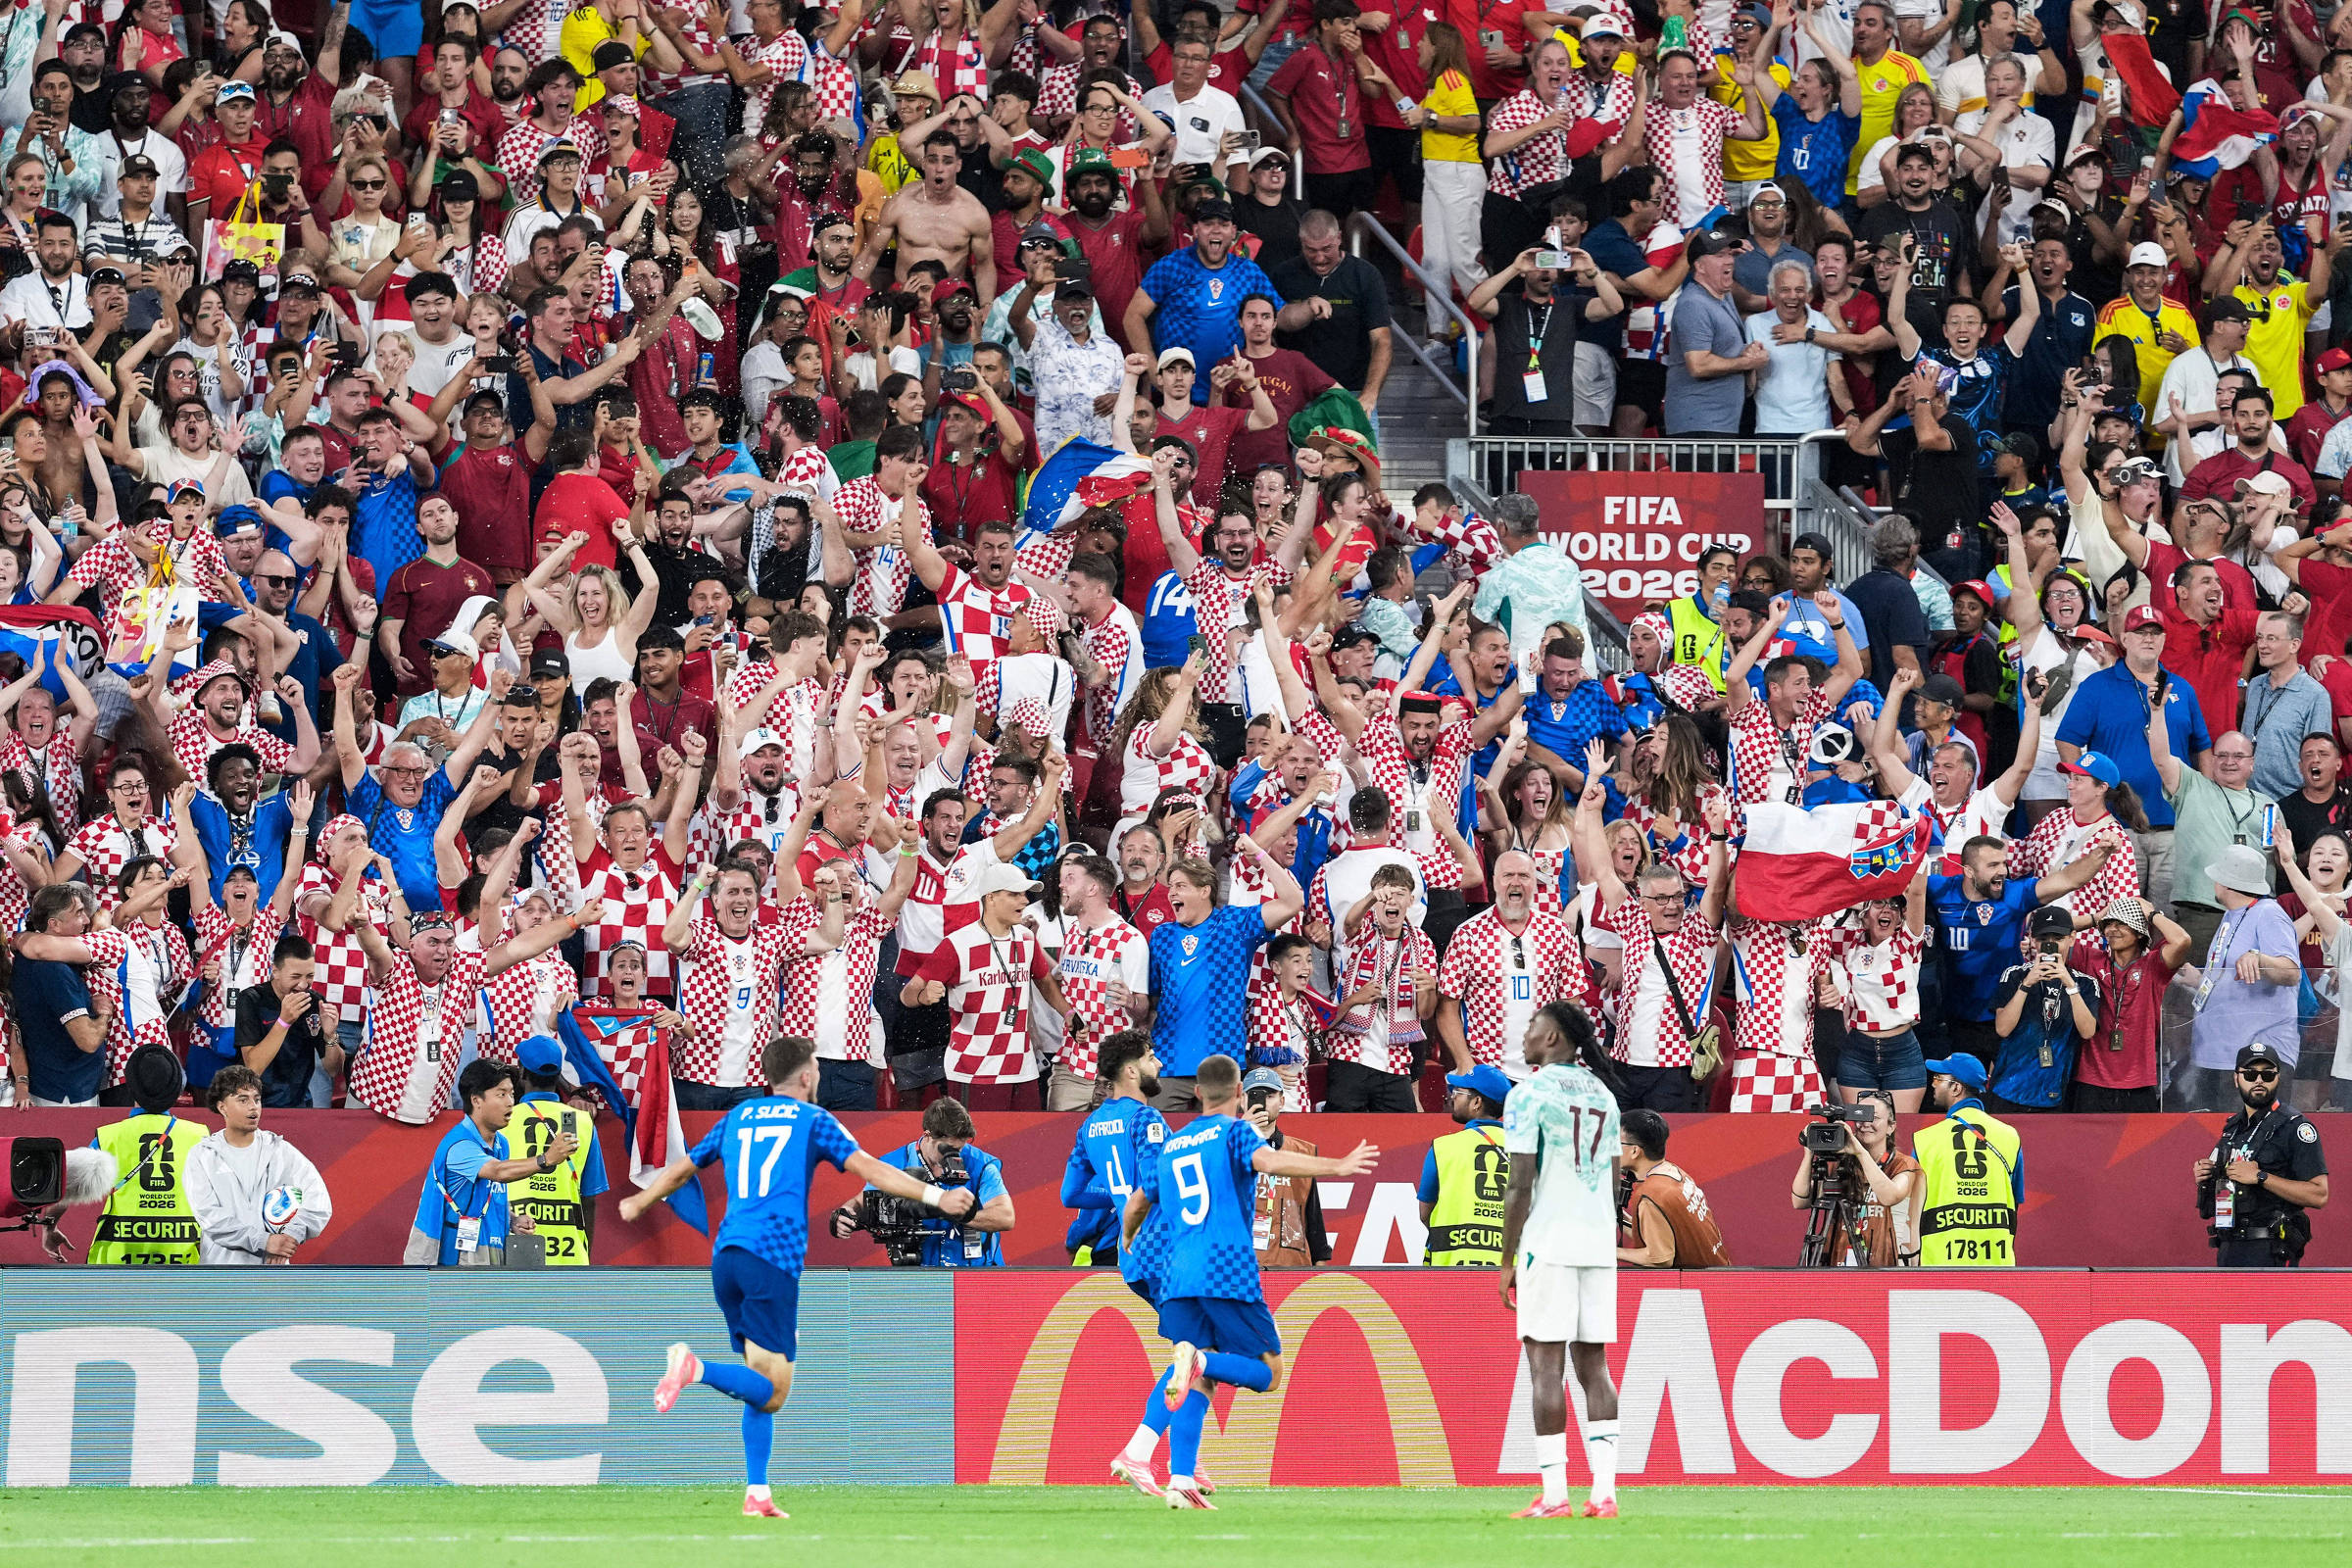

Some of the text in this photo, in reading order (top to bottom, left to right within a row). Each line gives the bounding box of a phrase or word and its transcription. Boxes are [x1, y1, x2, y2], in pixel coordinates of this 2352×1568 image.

[1792, 148, 1810, 171] 10
[1604, 497, 1683, 524] FIFA
[1539, 531, 1671, 562] WORLD
[1154, 571, 1193, 616] 14
[1581, 569, 1698, 599] 2026
[916, 871, 939, 903] 10
[1948, 926, 1970, 952] 10
[736, 987, 752, 1010] 9
[1510, 975, 1530, 1001] 10
[740, 1106, 755, 1121] P.
[1568, 1104, 1606, 1174] 17
[738, 1125, 793, 1200] 17
[1105, 1144, 1134, 1200] 4
[149, 1179, 167, 1188] FIFA
[1172, 1152, 1211, 1226] 9
[1483, 1188, 1499, 1198] FIFA
[1957, 1188, 1988, 1197] 2026
[138, 1200, 176, 1209] 2026
[1473, 1208, 1505, 1219] 2026
[1945, 1239, 2007, 1261] 17811
[1497, 1289, 2352, 1479] McDon
[6, 1325, 610, 1487] nse
